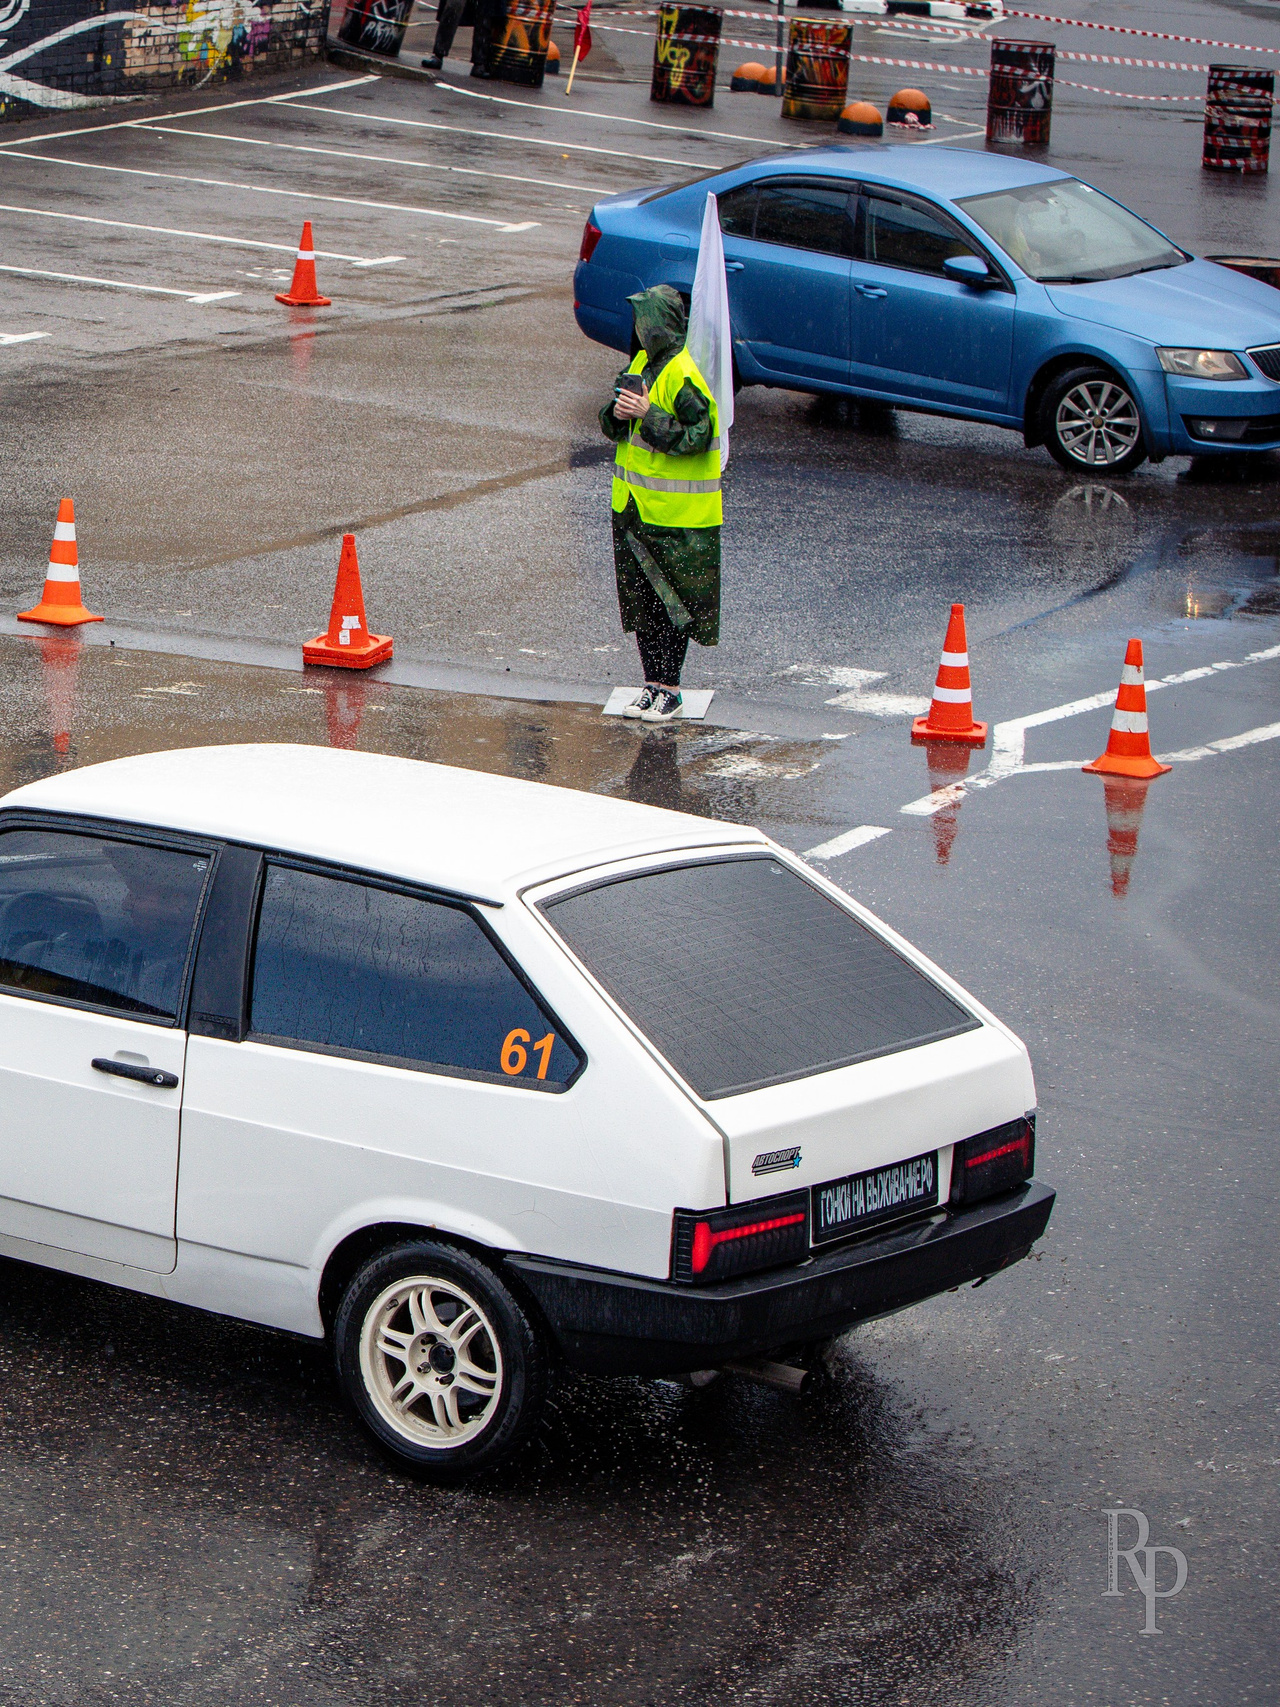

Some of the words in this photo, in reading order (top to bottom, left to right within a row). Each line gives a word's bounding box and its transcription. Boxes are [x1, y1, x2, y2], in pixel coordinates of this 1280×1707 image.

[500, 1028, 555, 1080] 61
[753, 1148, 800, 1167] АВТОСПОРТ
[821, 1183, 851, 1228] ГОНКИ
[852, 1179, 865, 1217] НА
